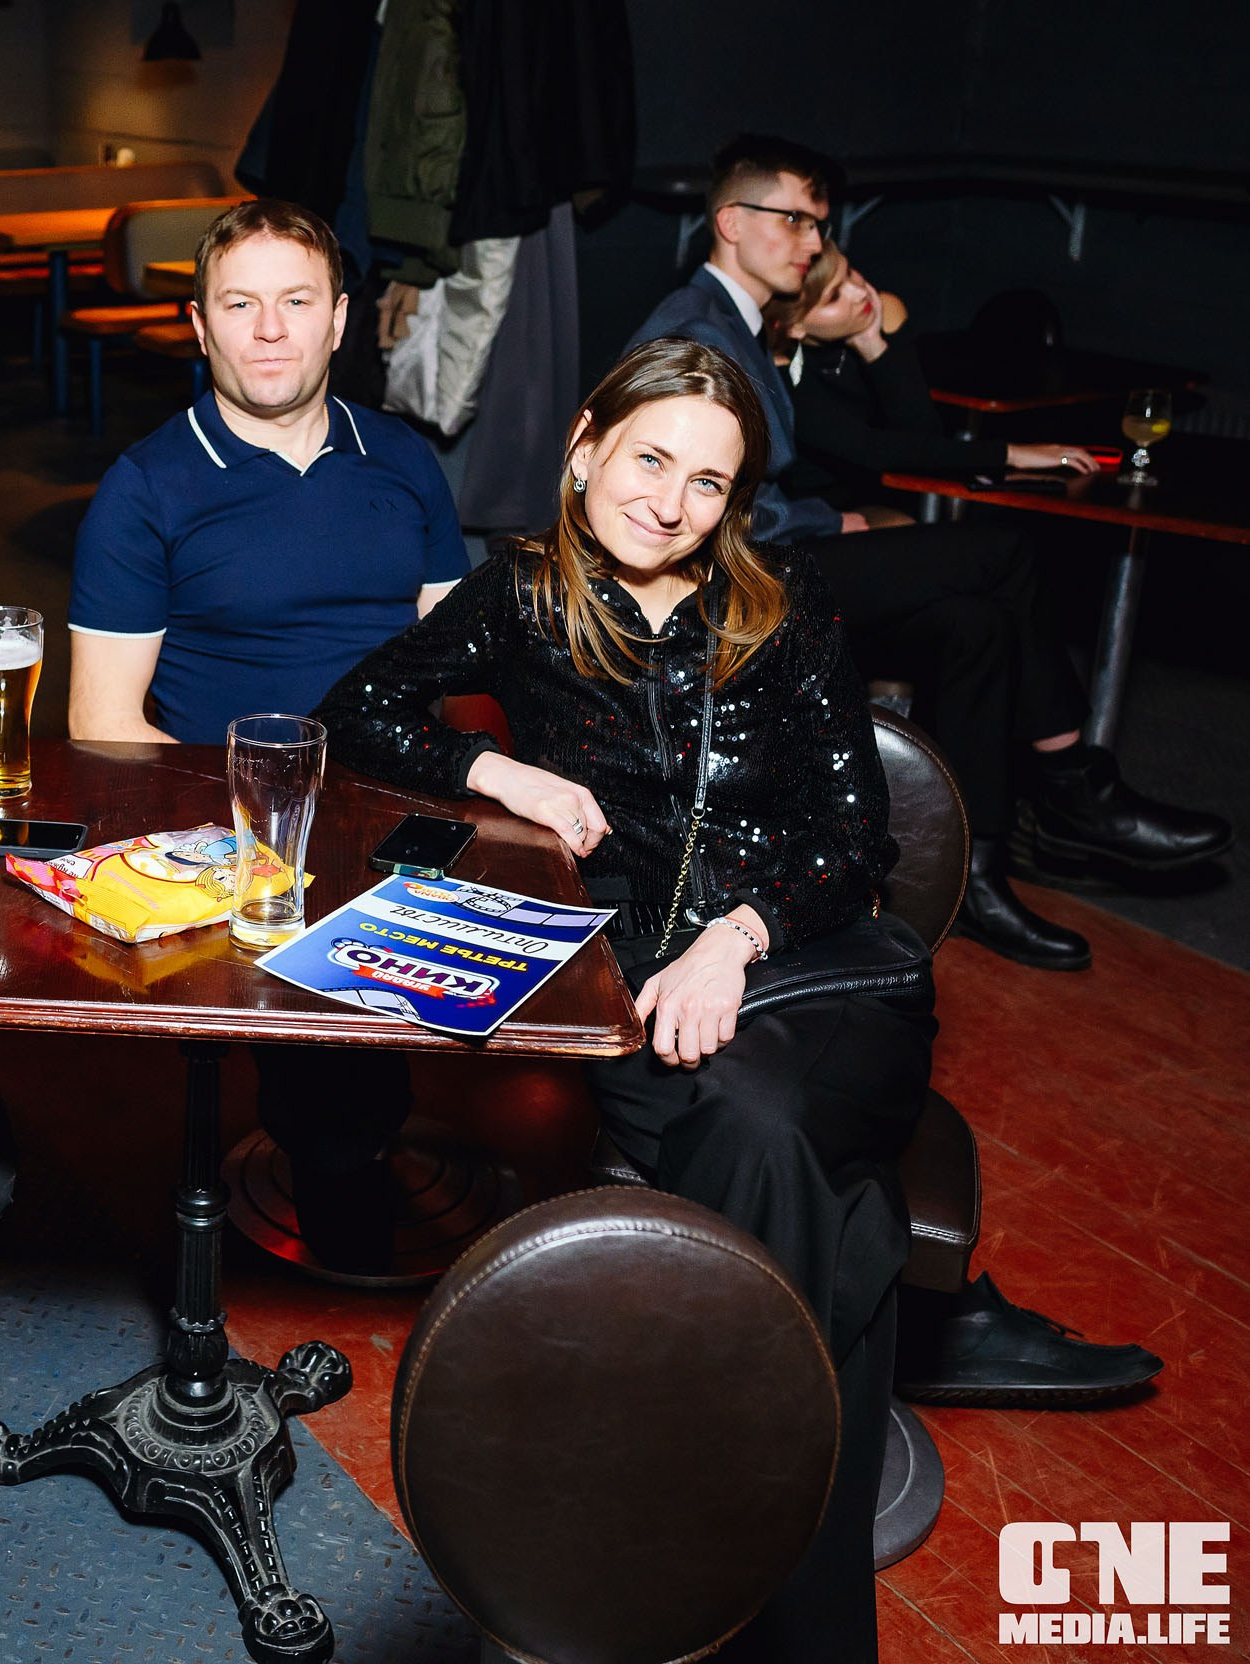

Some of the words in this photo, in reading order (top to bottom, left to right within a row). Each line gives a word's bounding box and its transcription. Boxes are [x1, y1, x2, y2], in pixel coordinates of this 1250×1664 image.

[359, 922, 440, 949] МЕСТО
[390, 905, 548, 954] Оптимисты
[440, 944, 529, 971] ТРЕТЬЕ
[347, 950, 484, 993] КИНО
[372, 970, 430, 991] УГАДАЙ
